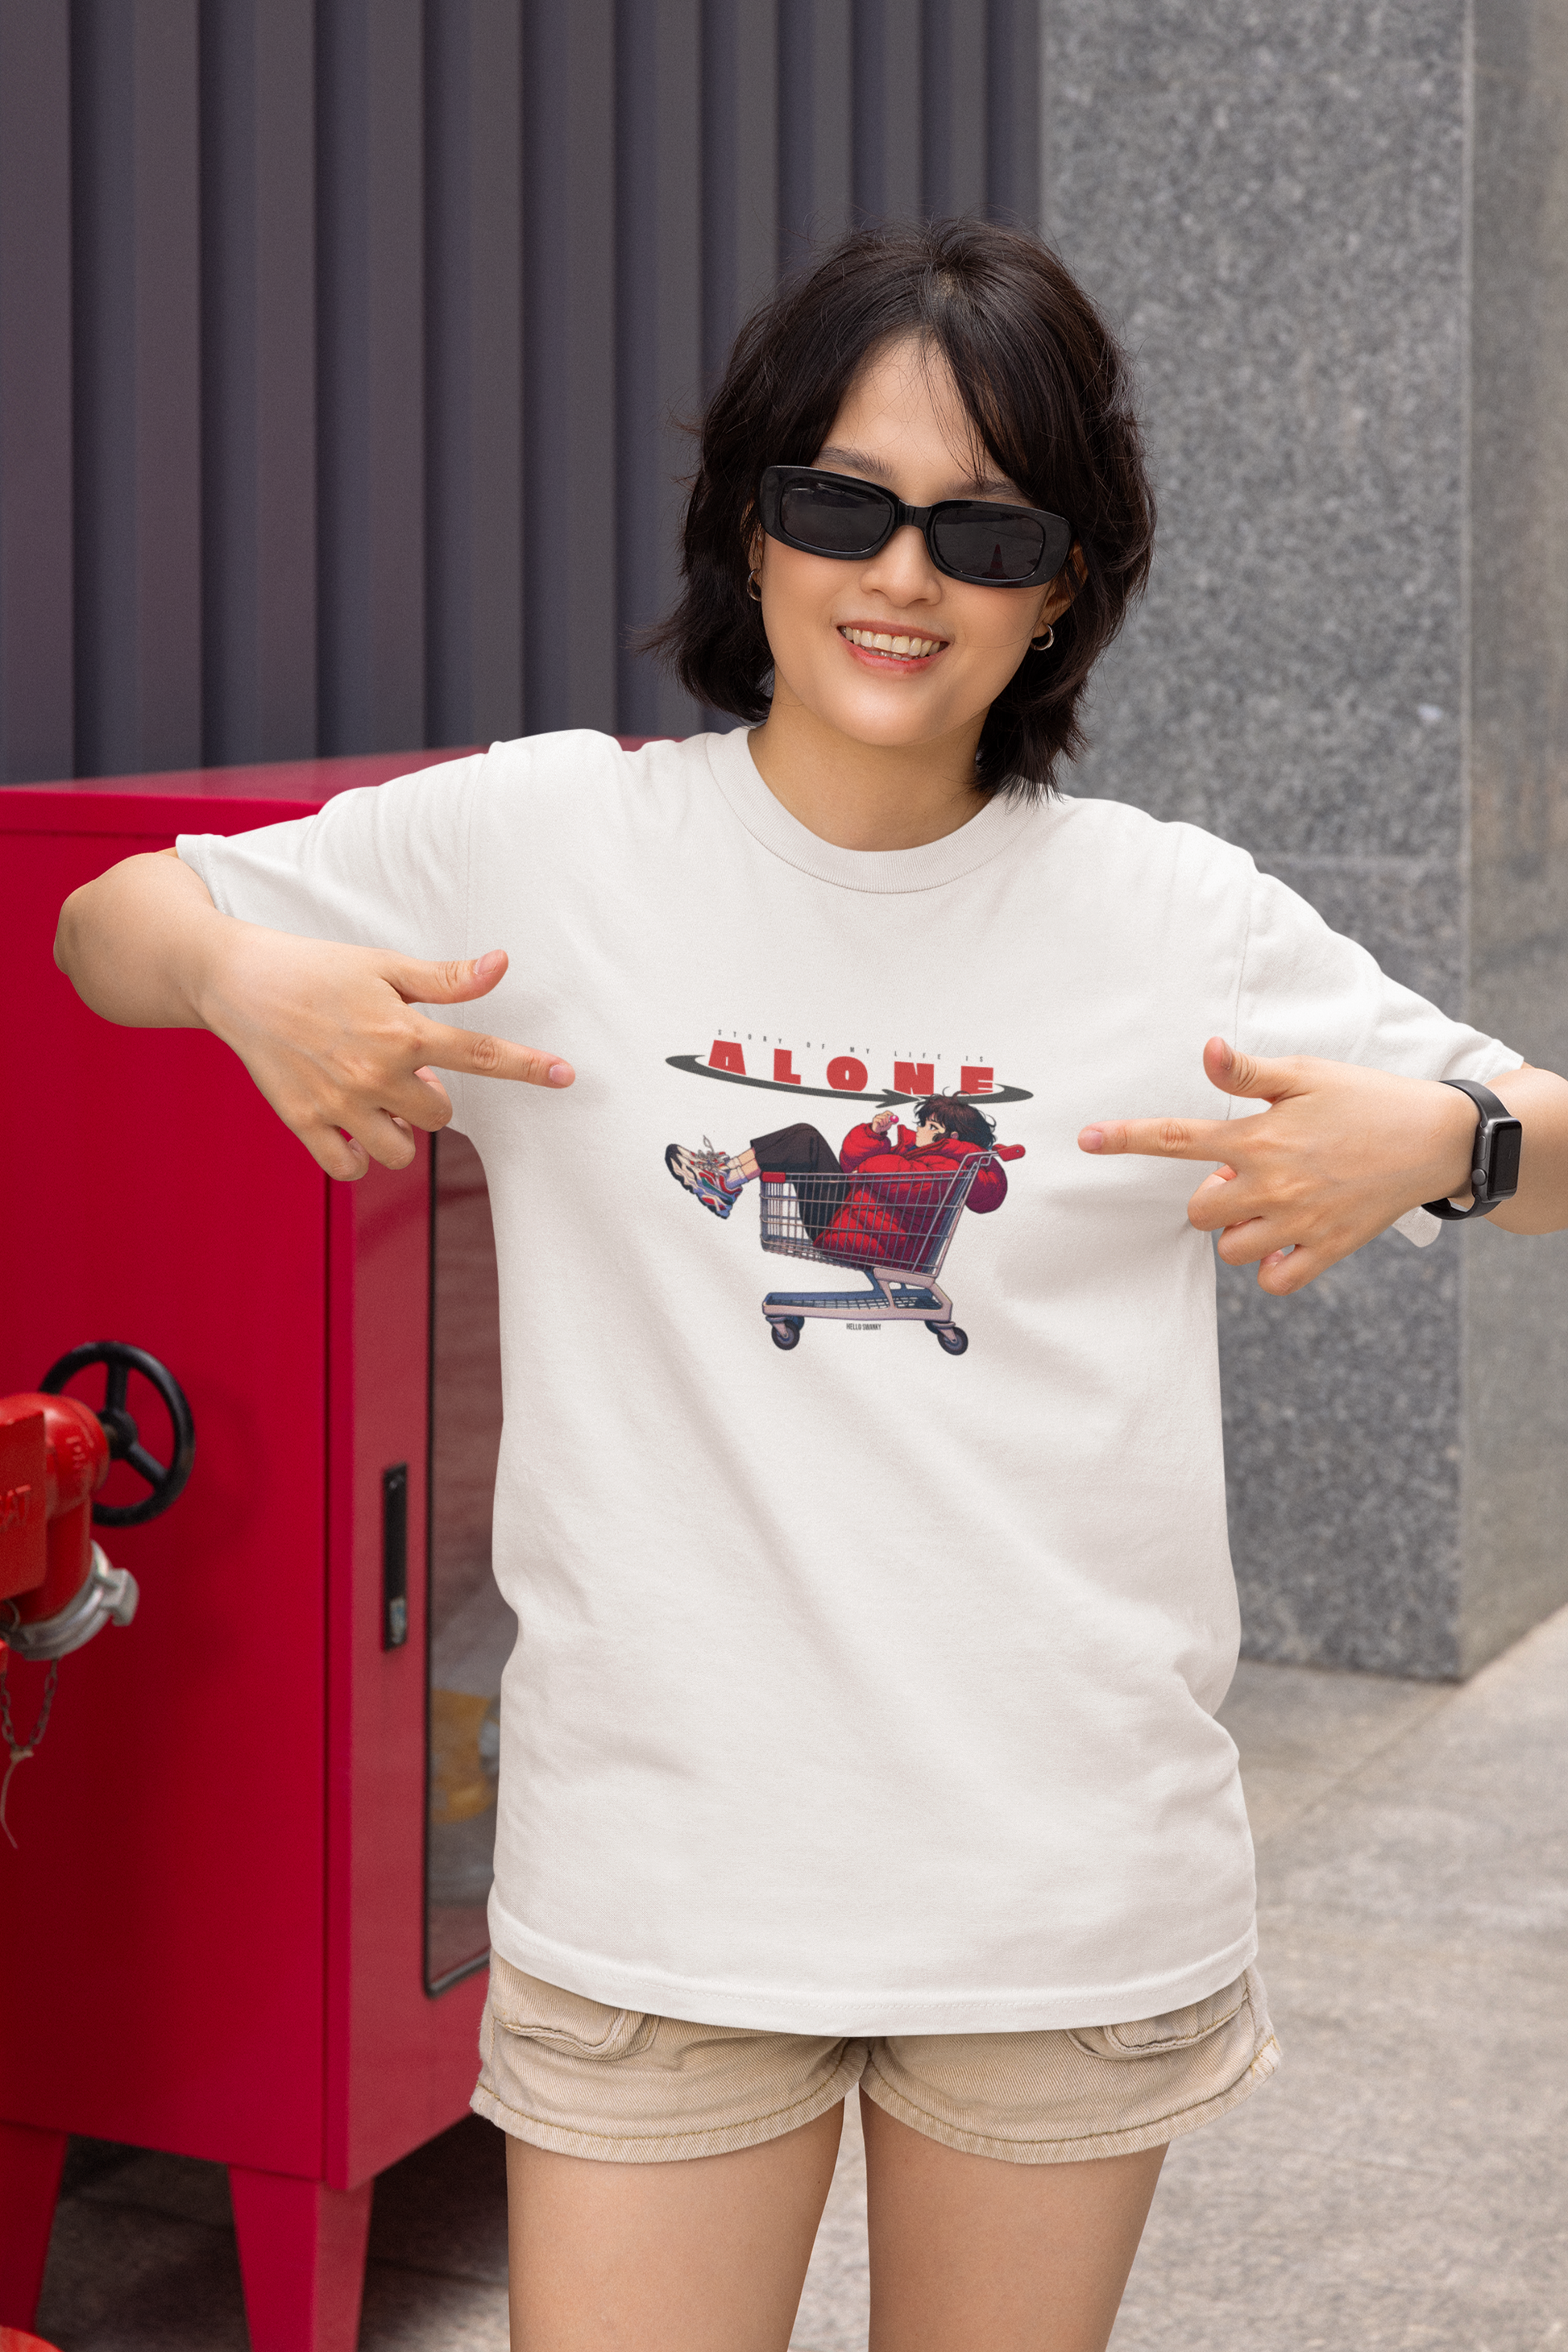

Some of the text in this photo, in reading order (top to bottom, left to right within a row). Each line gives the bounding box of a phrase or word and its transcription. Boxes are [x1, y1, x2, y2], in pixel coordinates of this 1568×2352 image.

[718, 1029, 984, 1063] STORY OF MY LIFE IS
[707, 1039, 994, 1095] ALONE
[846, 1322, 862, 1330] HELLO
